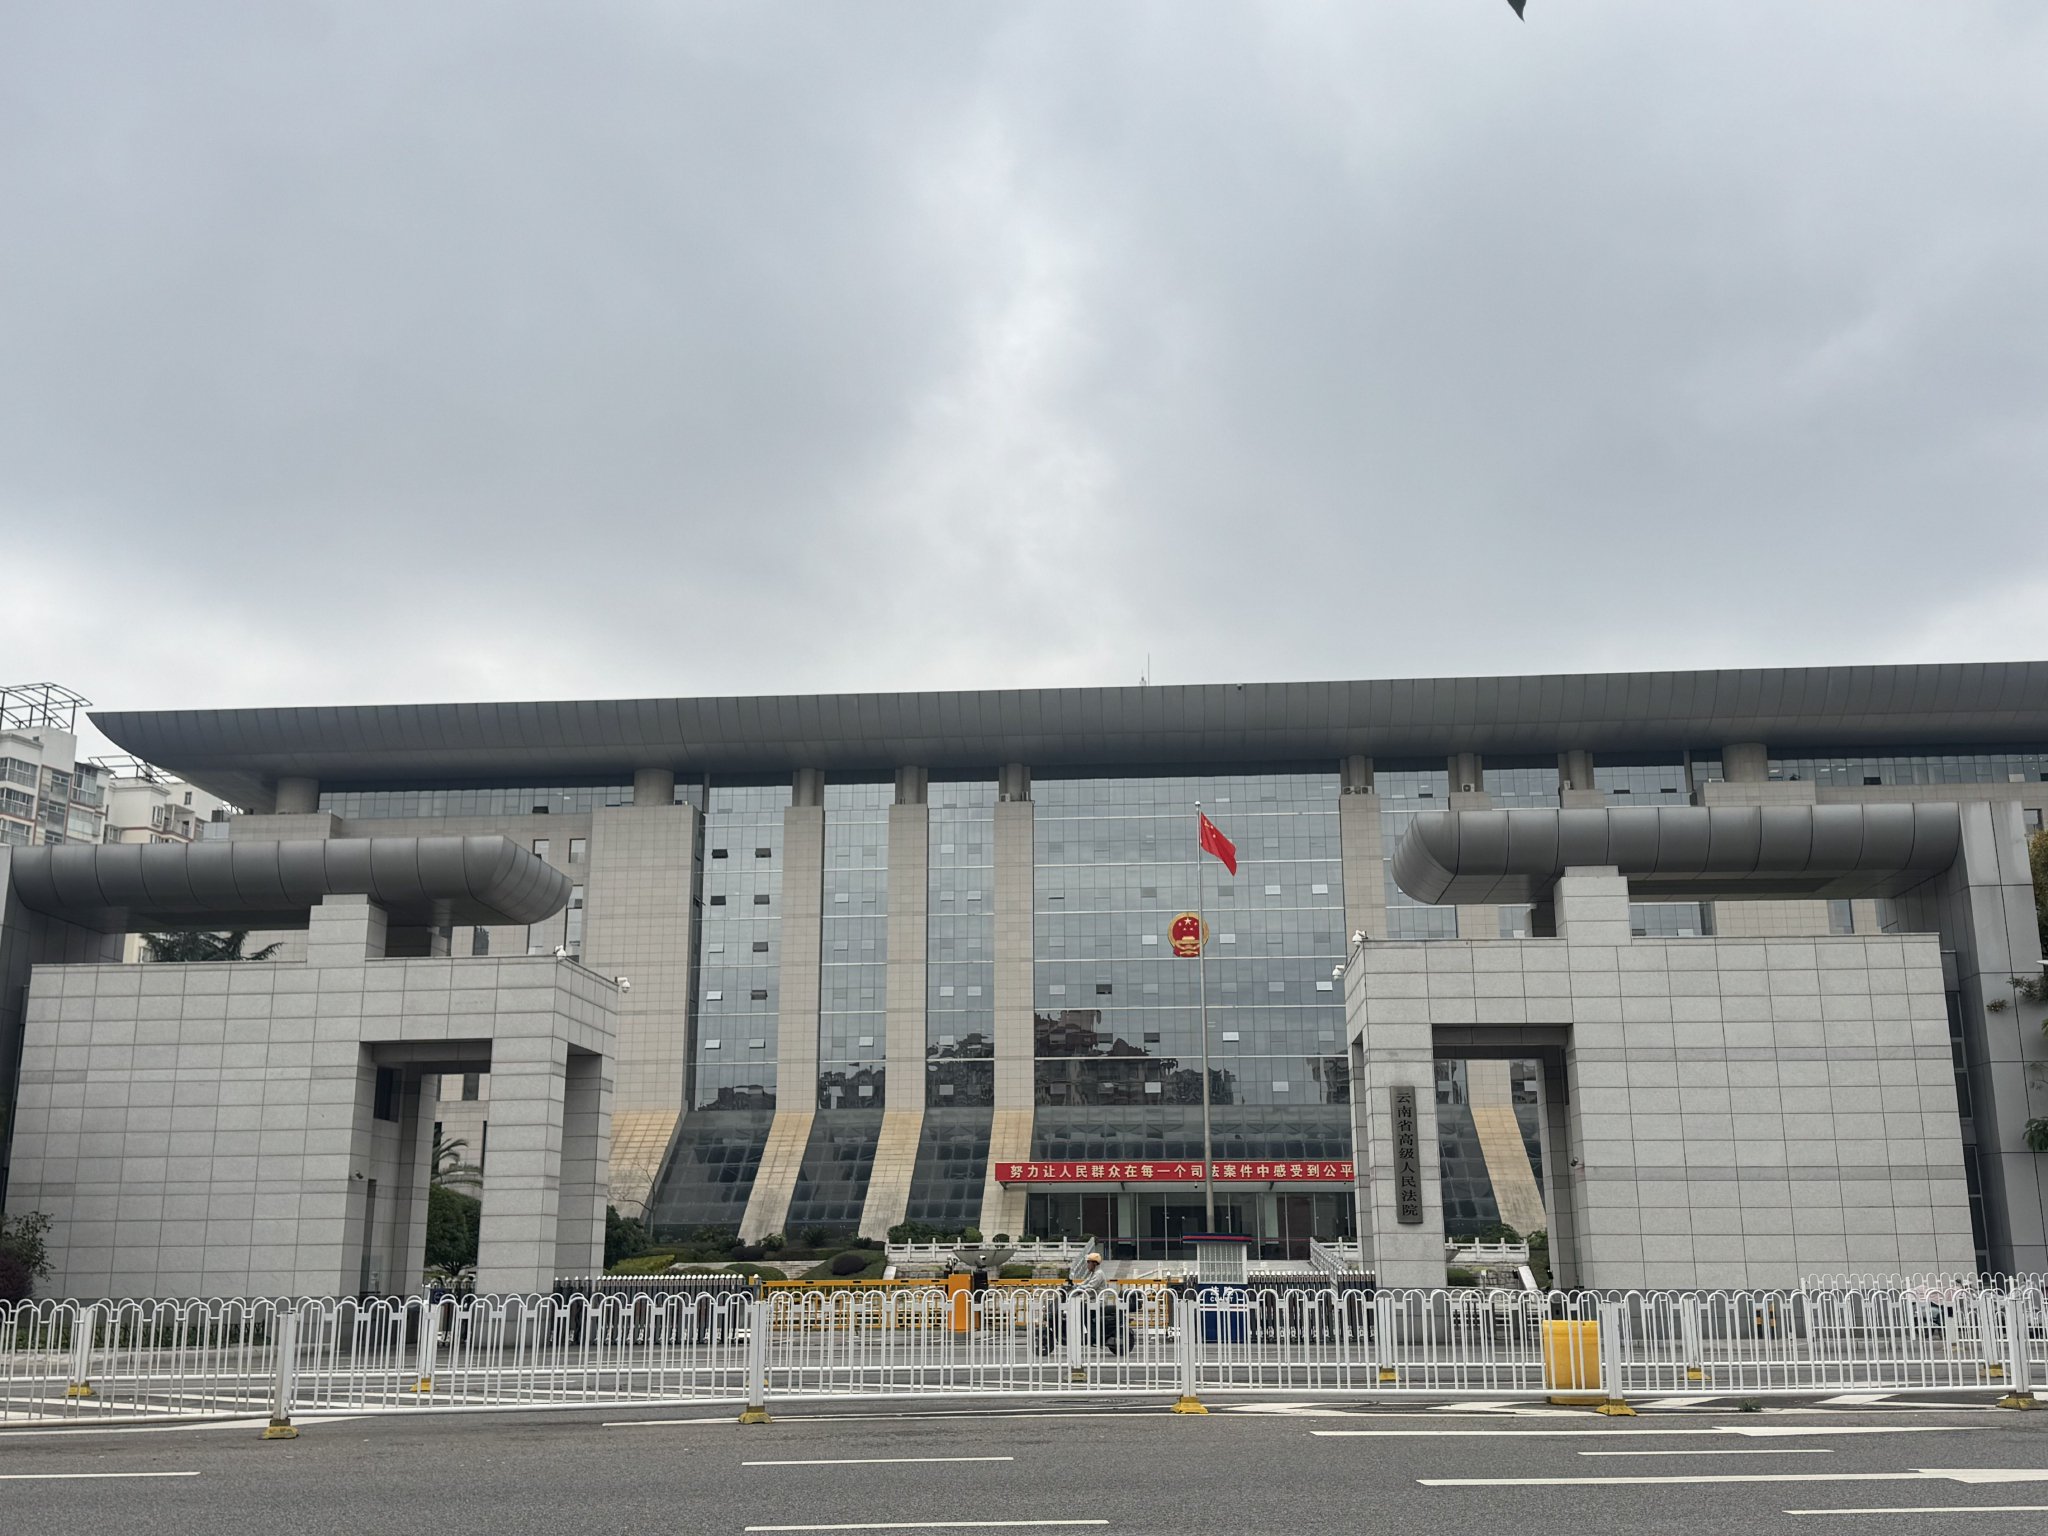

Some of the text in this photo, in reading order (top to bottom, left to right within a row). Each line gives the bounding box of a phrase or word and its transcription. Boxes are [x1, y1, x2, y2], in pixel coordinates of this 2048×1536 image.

[1396, 1092, 1418, 1216] 云南省高级人民法院
